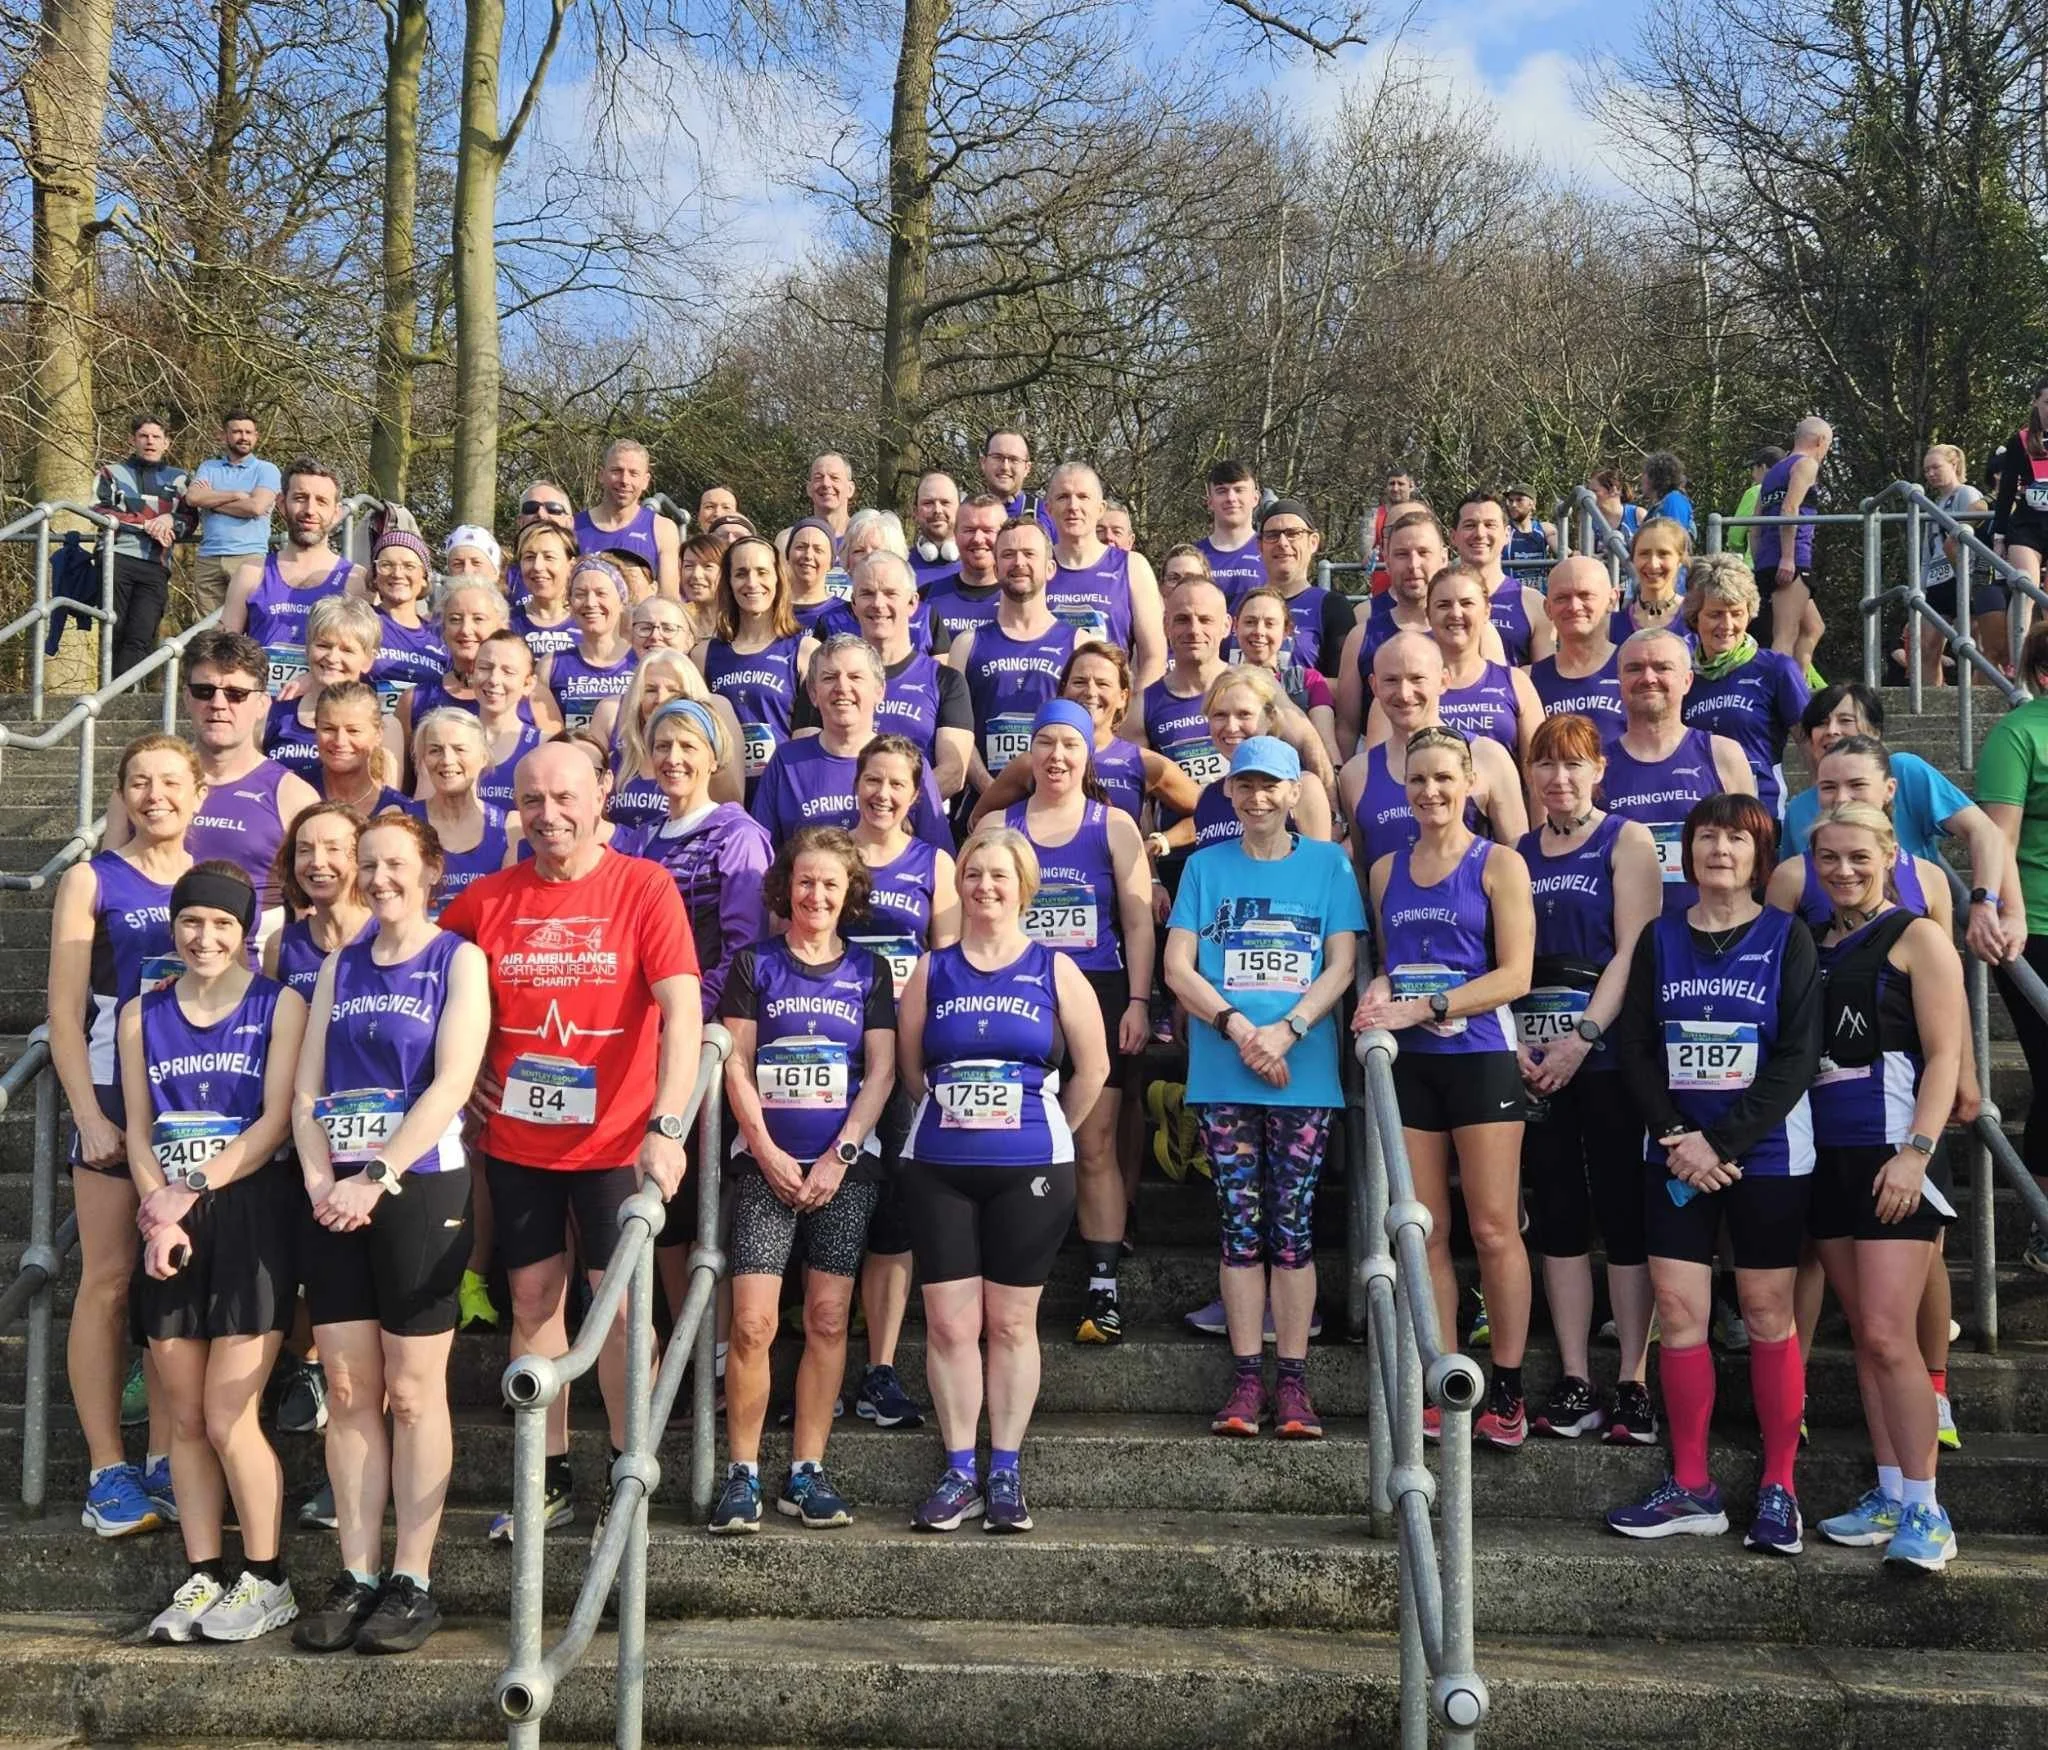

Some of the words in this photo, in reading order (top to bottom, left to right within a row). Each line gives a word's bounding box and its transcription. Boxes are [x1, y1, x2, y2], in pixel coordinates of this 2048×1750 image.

[1211, 569, 1260, 578] RINGWELL
[270, 602, 312, 615] SPRINGW
[1047, 593, 1112, 605] PRINGWELL
[981, 656, 1062, 680] SPRINGWELL
[560, 684, 629, 701] SPRINGWE
[711, 670, 785, 693] SPRINGWELL
[875, 700, 922, 721] GWELL
[1438, 703, 1505, 714] RINGWELL
[1545, 695, 1622, 717] PRINGWELL
[1684, 694, 1754, 720] SPRINGWELL
[1158, 715, 1209, 733] SPRING
[269, 744, 319, 760] SPRING
[608, 792, 670, 812] SPRINGWE
[802, 795, 860, 817] SPRING
[1609, 789, 1701, 810] SPRINGWELL
[193, 815, 247, 832] GWELL
[1040, 866, 1087, 884] INGWELL
[1530, 873, 1598, 896] RINGWELL
[869, 889, 921, 917] GWELL
[1025, 908, 1086, 929] 2376
[1391, 906, 1458, 928] SPRINGWELL
[500, 953, 523, 965] AIR
[526, 952, 617, 965] AMBULANCE
[1238, 951, 1299, 973] 1562
[498, 965, 564, 976] NORTHERN
[567, 964, 617, 976] IRELAND
[532, 977, 581, 988] CHARITY
[1662, 977, 1766, 1005] SPRINGWELL
[332, 993, 432, 1024] SPRINGWELL
[766, 996, 858, 1025] SPRINGWELL
[936, 995, 1040, 1023] SPRINGWELL
[1524, 1014, 1575, 1036] 2719
[1679, 1045, 1742, 1067] 2187
[149, 1051, 261, 1085] SPRINGWELL
[774, 1066, 830, 1087] 1616
[529, 1086, 566, 1111] 84
[947, 1084, 1008, 1106] 1752
